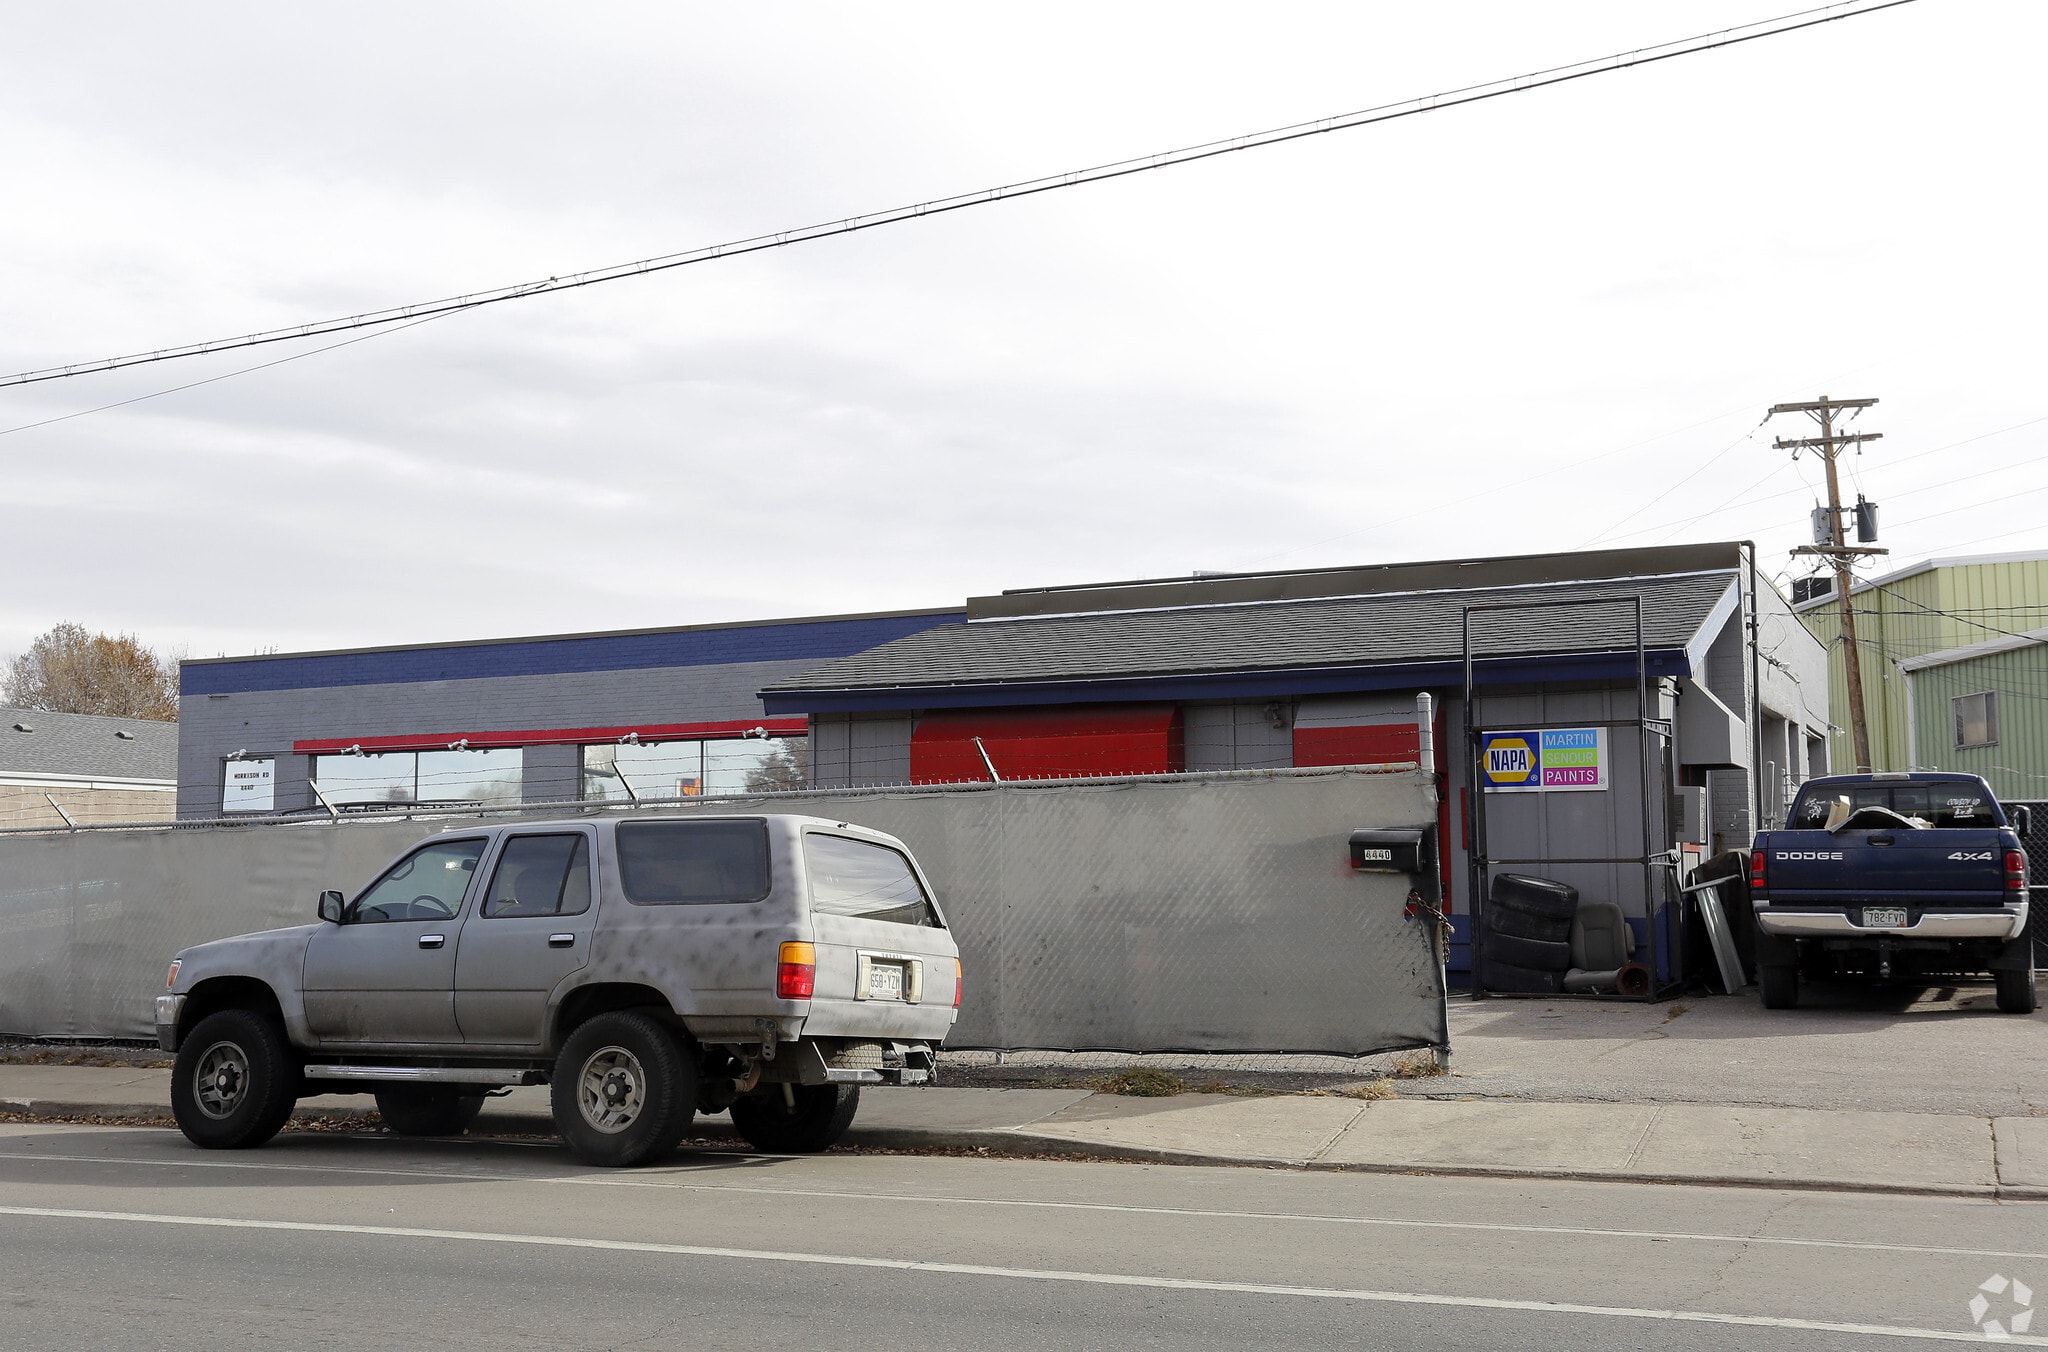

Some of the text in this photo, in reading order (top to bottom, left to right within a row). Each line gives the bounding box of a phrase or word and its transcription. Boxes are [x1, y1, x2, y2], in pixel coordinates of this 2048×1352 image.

[1545, 733, 1594, 746] MARTIN
[1490, 749, 1528, 772] NAPA
[1546, 751, 1594, 765] SENOUR
[1546, 769, 1595, 783] PAINTS
[1365, 850, 1391, 860] 4440
[1776, 852, 1843, 860] DODGE
